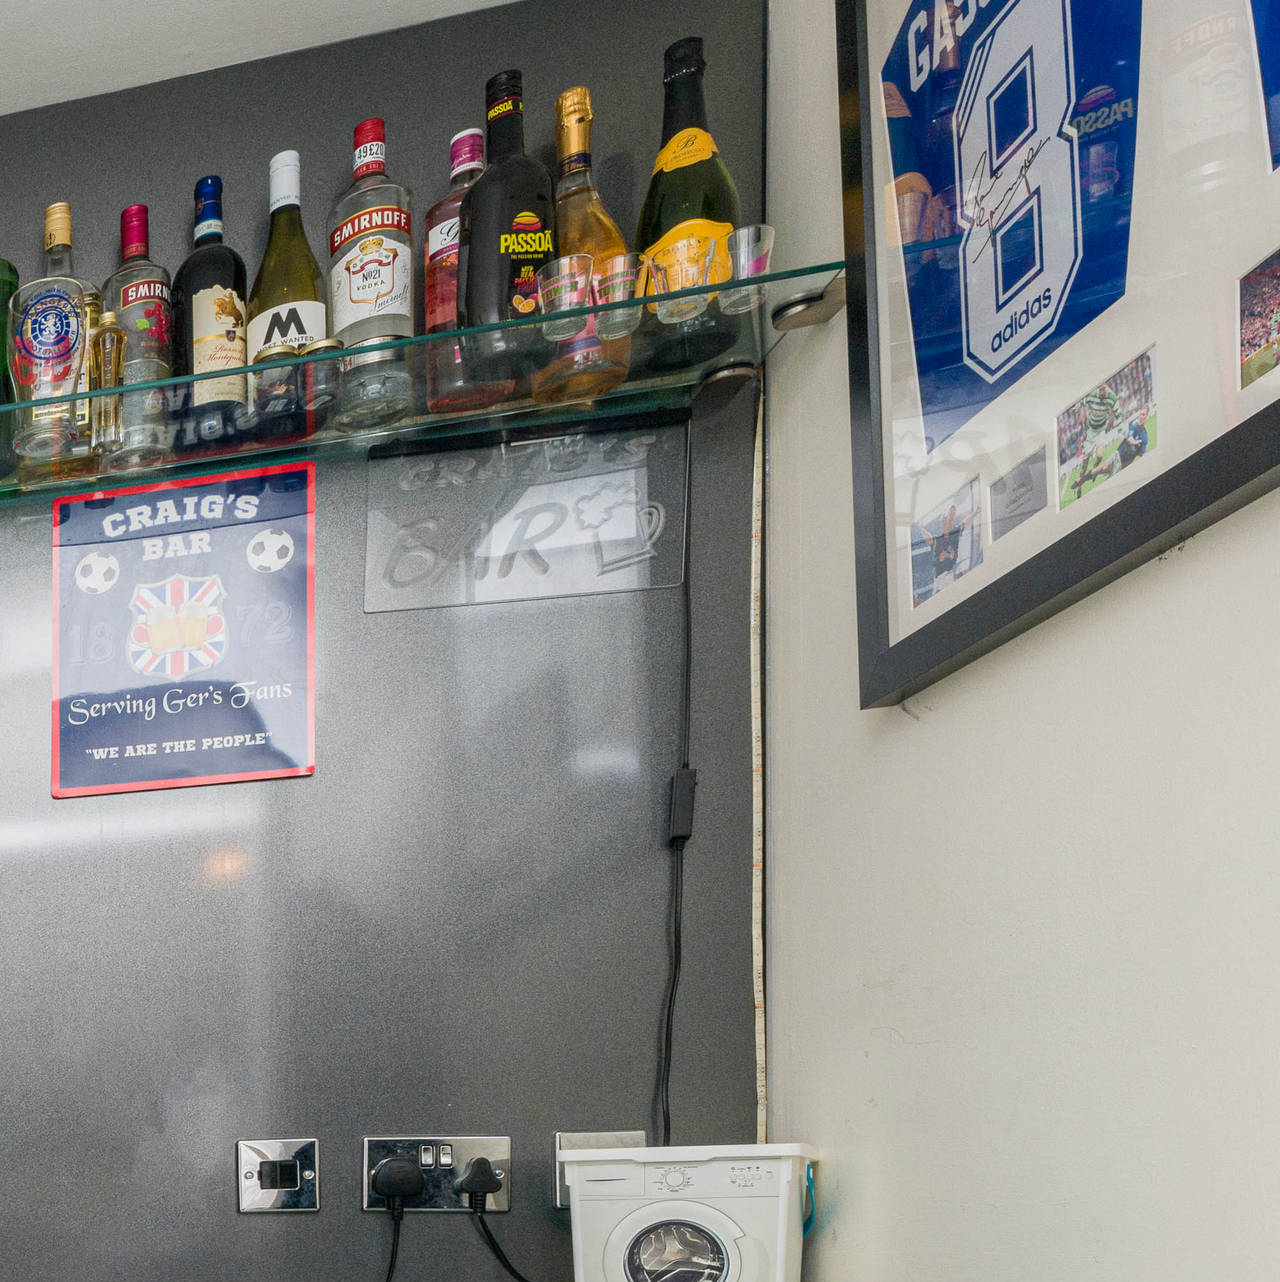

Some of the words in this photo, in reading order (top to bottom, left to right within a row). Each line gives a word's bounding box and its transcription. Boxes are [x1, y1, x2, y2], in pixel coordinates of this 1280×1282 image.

[907, 0, 988, 92] GAS
[334, 211, 406, 247] SMIRNOFF
[356, 280, 386, 292] VODKA
[991, 288, 1052, 353] adidas
[280, 335, 314, 345] WANTED
[102, 494, 260, 538] CRAIG'S
[142, 532, 212, 561] BAR
[68, 694, 156, 725] Serving
[162, 685, 223, 714] Ger's
[229, 681, 293, 709] Fans
[124, 743, 157, 758] ARE
[162, 740, 197, 754] THE
